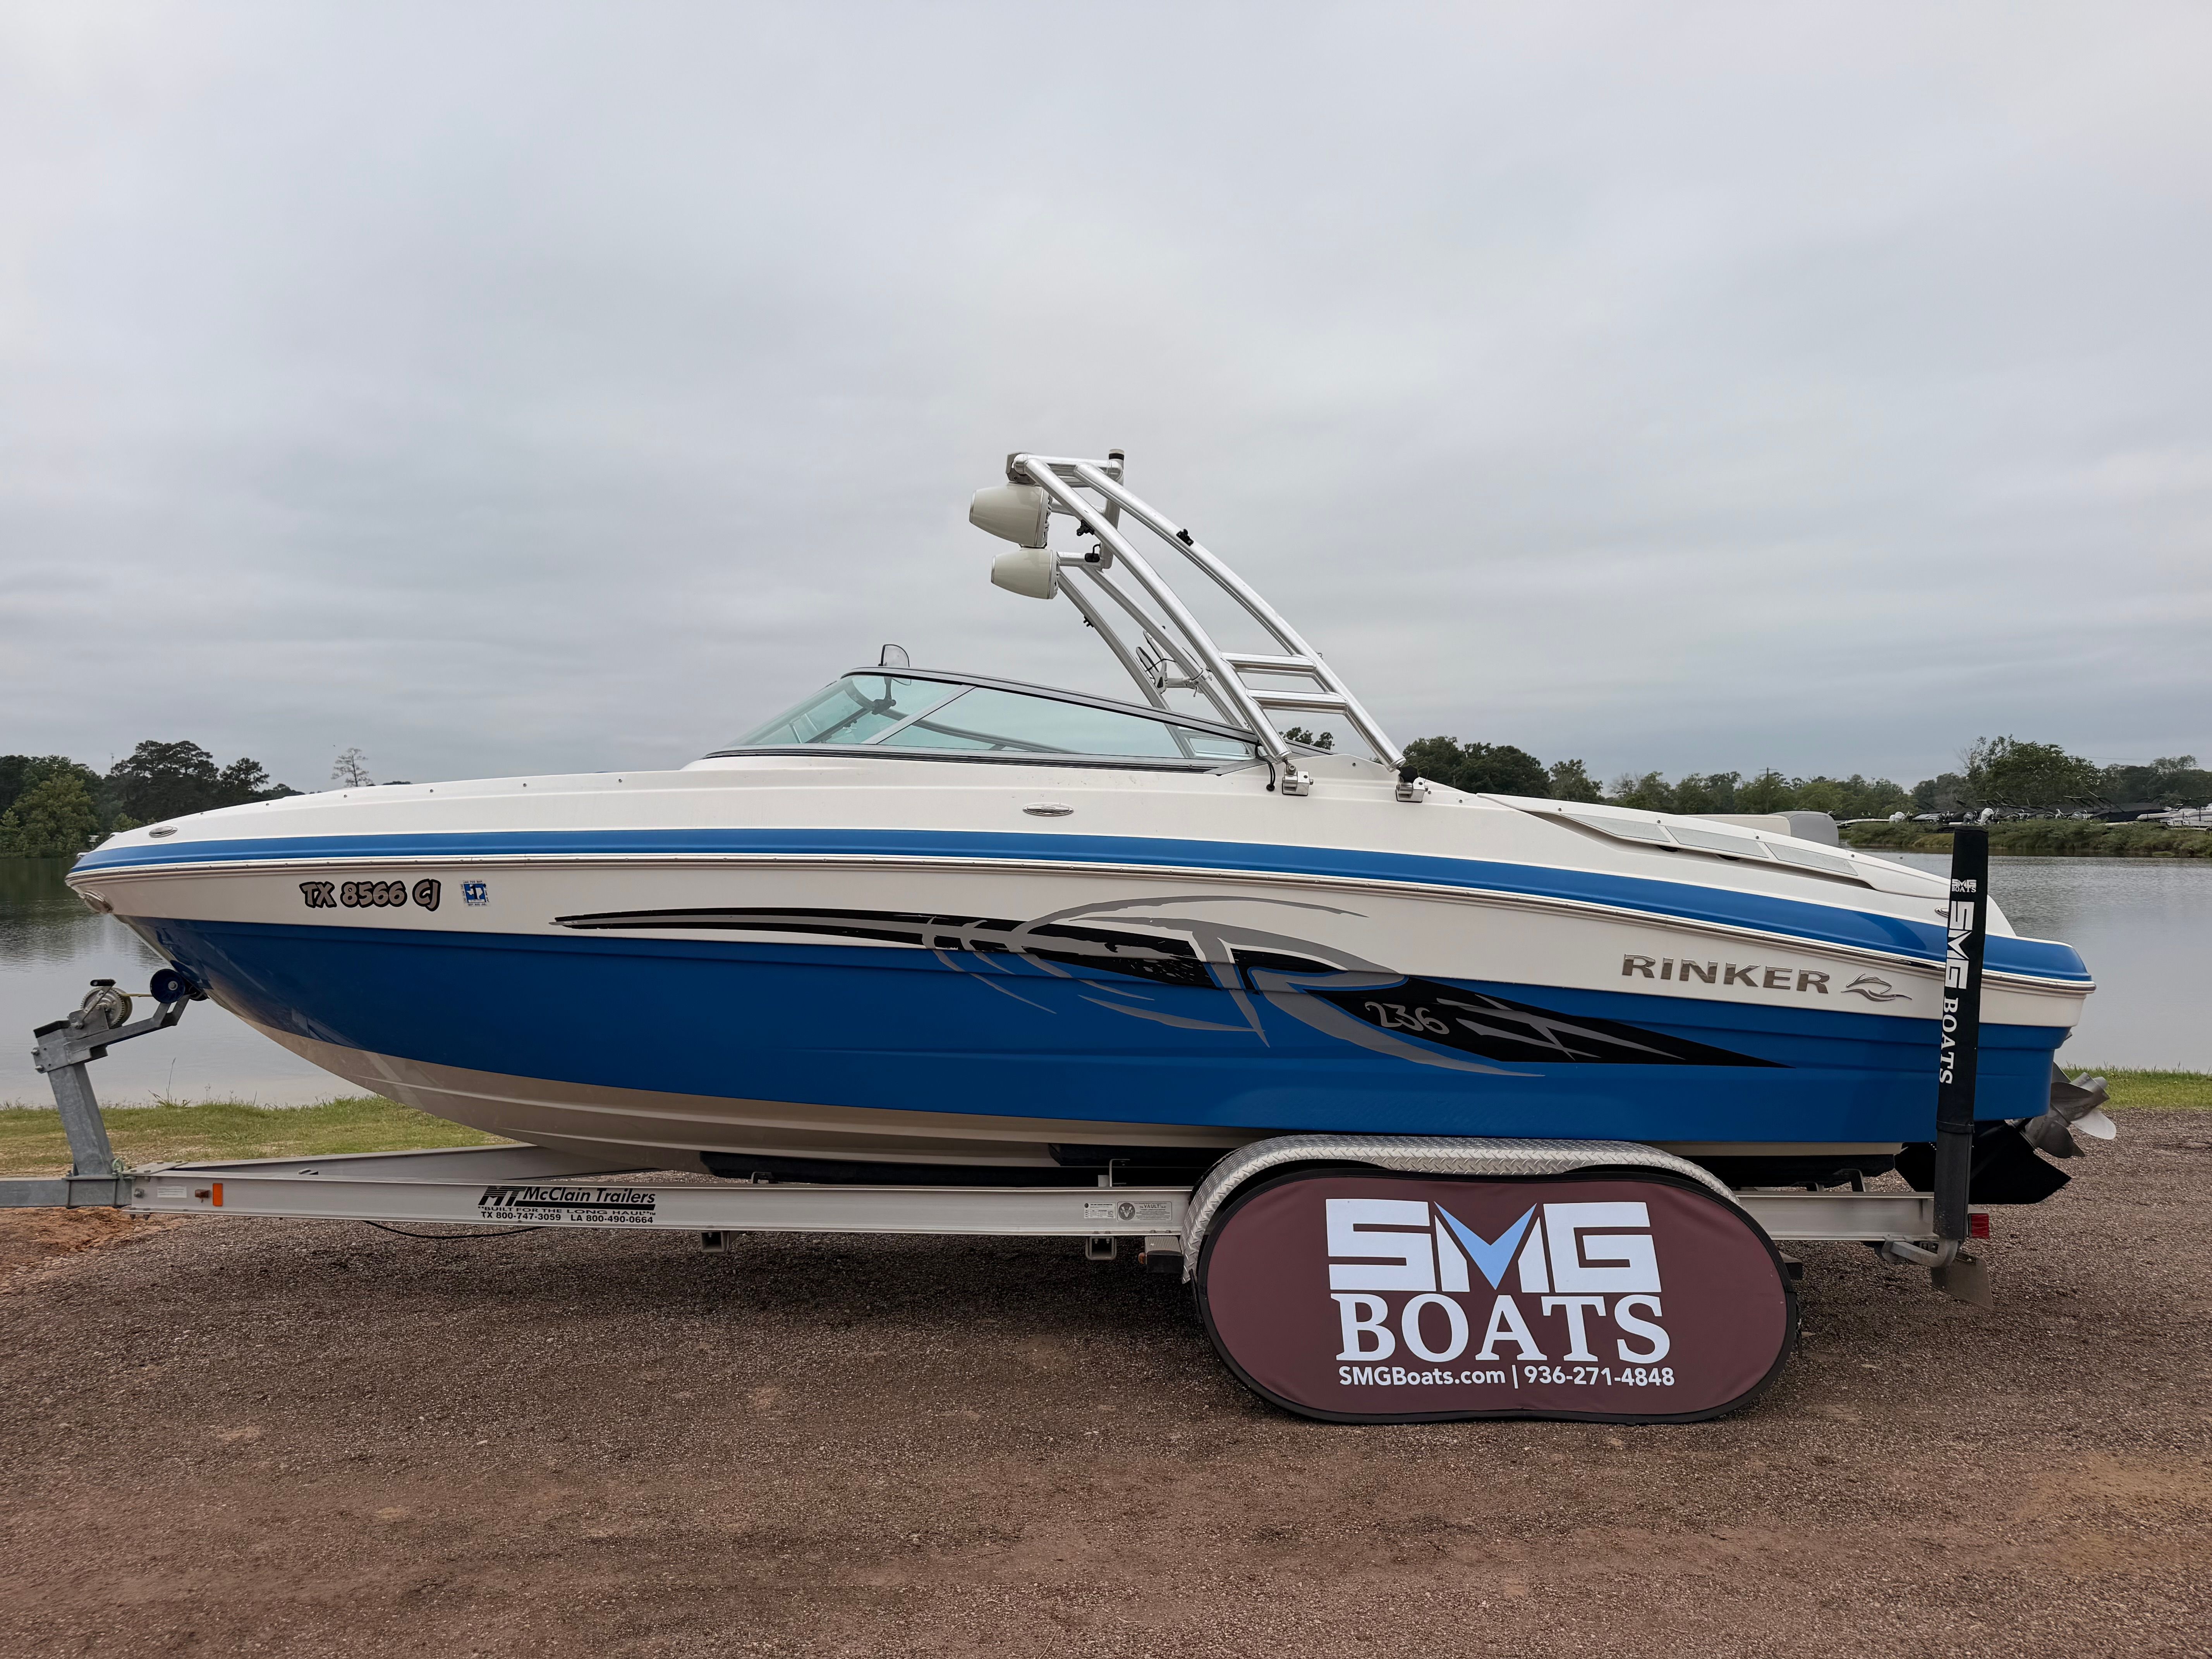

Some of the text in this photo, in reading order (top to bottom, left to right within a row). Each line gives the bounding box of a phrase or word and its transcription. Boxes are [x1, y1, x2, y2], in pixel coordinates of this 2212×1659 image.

[299, 881, 337, 908] TX
[340, 881, 408, 908] 8566
[412, 879, 441, 911] CJ
[1952, 879, 1977, 887] SMG
[1622, 953, 1830, 994] RINKER
[1939, 900, 1975, 1084] SMG BOATS
[1365, 1001, 1450, 1034] 236
[523, 1187, 591, 1201] McClain
[596, 1188, 656, 1203] Trailers
[496, 1212, 561, 1220] 800-747-3059
[586, 1215, 653, 1223] 800-490-0664
[1326, 1199, 1661, 1293] SMG
[1331, 1293, 1670, 1364] BOATS
[1339, 1366, 1506, 1386] SMGBoats.com
[1524, 1365, 1675, 1386] 936-271-4848
